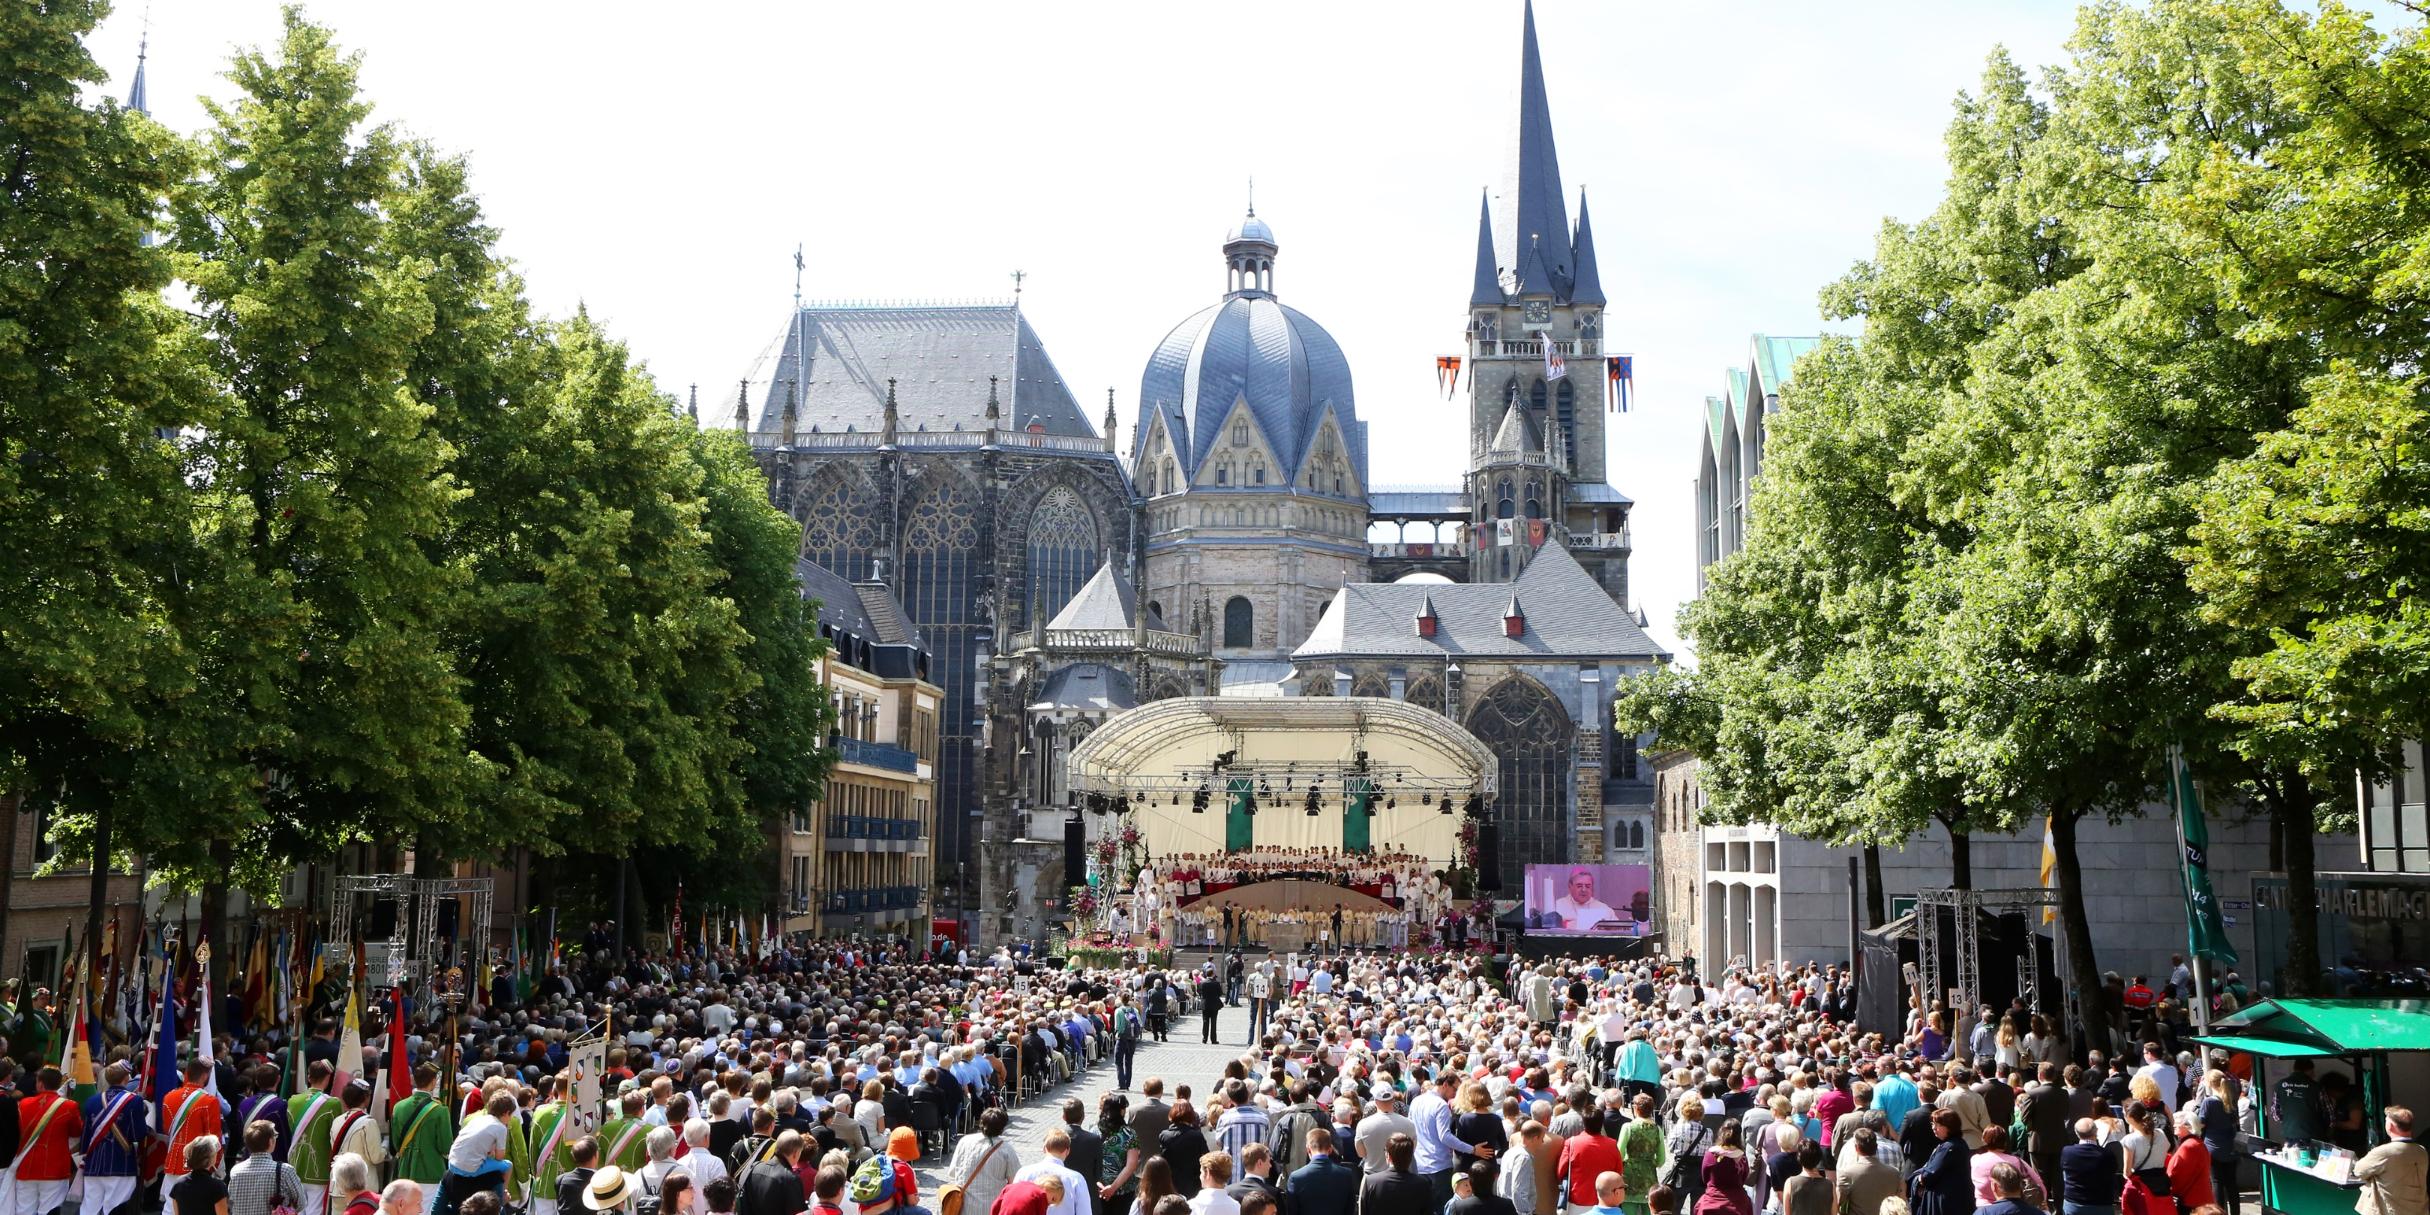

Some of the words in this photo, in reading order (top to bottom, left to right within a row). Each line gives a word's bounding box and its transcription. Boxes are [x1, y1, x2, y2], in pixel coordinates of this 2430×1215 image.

[1140, 952, 1145, 961] 9
[409, 965, 417, 974] 16
[1906, 971, 1917, 981] 11
[1016, 981, 1026, 991] 15
[1256, 984, 1265, 994] 14
[1952, 994, 1962, 1004] 13
